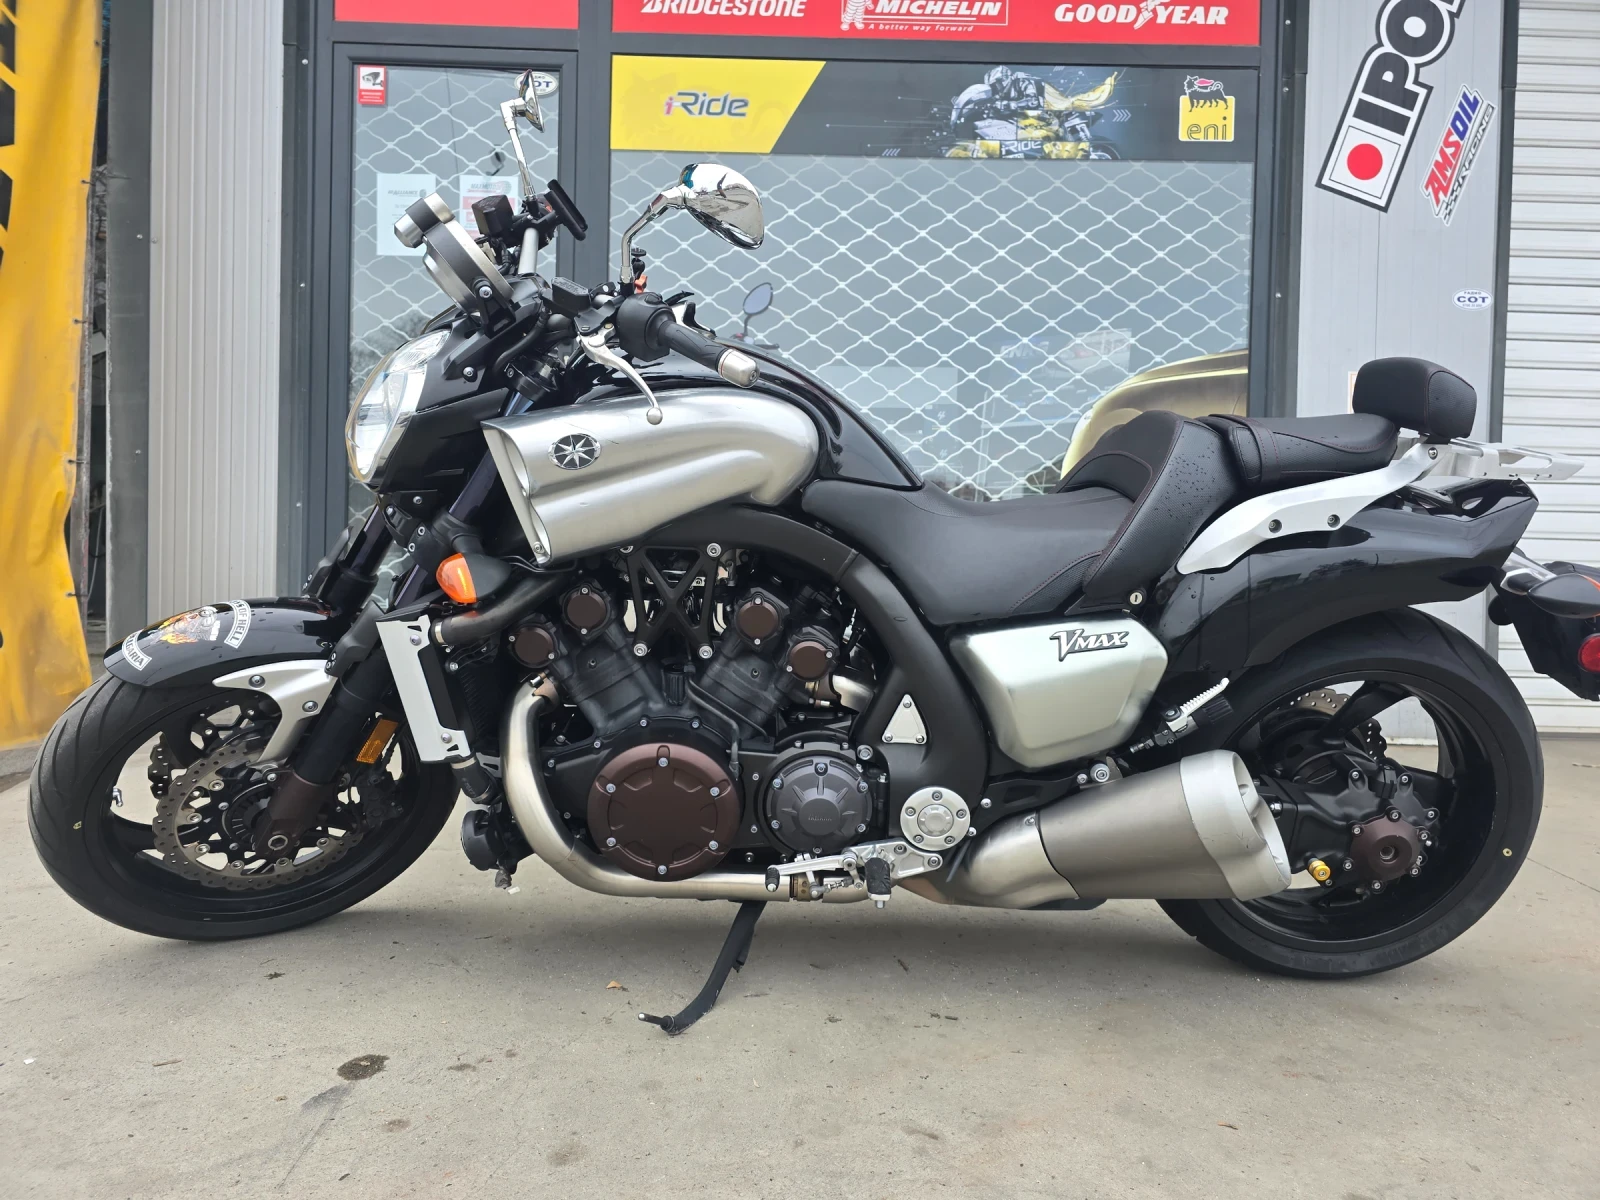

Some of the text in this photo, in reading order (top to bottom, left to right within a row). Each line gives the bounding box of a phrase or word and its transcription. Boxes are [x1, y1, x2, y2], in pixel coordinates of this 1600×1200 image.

[640, 0, 806, 17] BRIDGESTONE
[875, 0, 1002, 16] MICHELIN
[912, 25, 931, 33] way
[935, 24, 974, 32] forward
[1352, 0, 1454, 137] IPO
[1187, 116, 1227, 141] eni
[1424, 91, 1480, 208] AMSOIL
[229, 619, 247, 642] HELL
